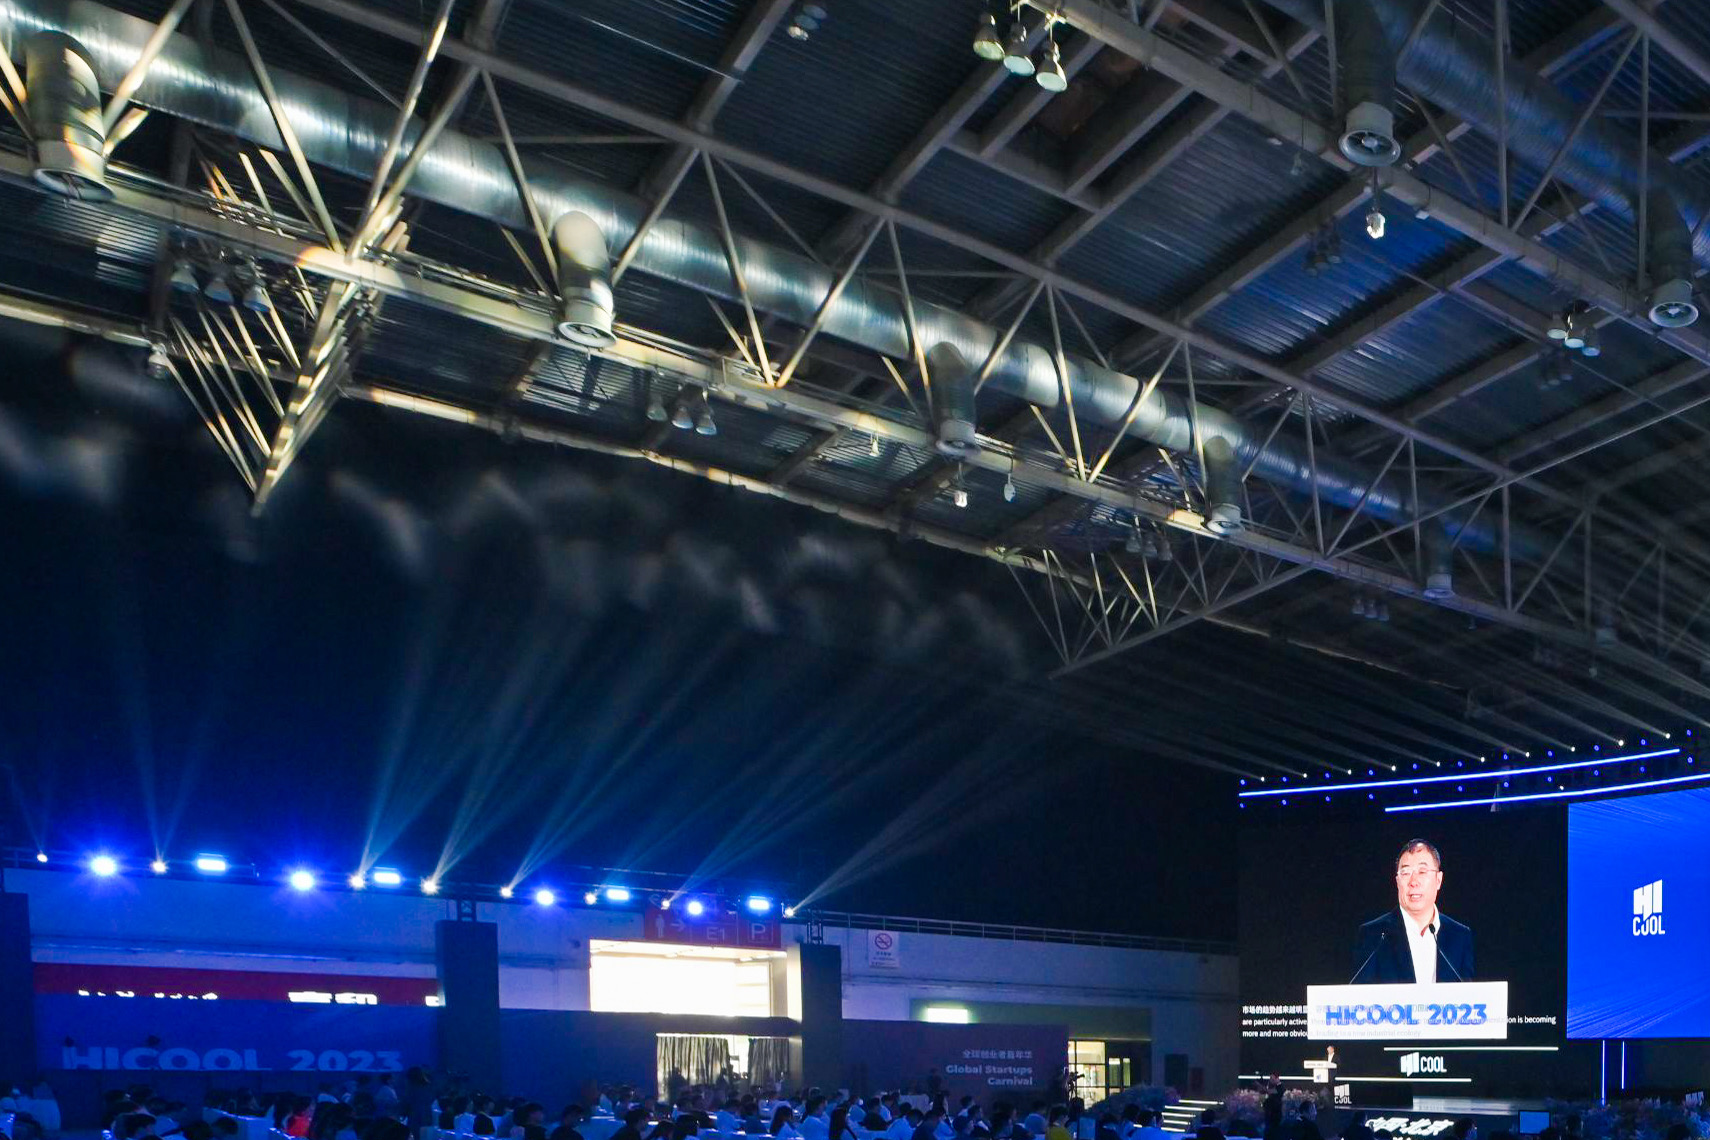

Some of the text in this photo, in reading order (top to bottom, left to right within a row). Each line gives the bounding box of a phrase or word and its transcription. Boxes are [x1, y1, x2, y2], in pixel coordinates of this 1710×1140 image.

[1325, 1004, 1420, 1026] HICOOL
[1428, 1003, 1488, 1025] 2023
[1254, 1017, 1287, 1027] particularly
[1524, 1015, 1557, 1025] becoming
[1242, 1030, 1258, 1038] more
[1260, 1029, 1271, 1037] and
[62, 1046, 402, 1072] HICOOL 2023
[1420, 1056, 1447, 1073] COOL
[946, 1065, 1032, 1075] Global Startups
[987, 1077, 1032, 1086] Carnival
